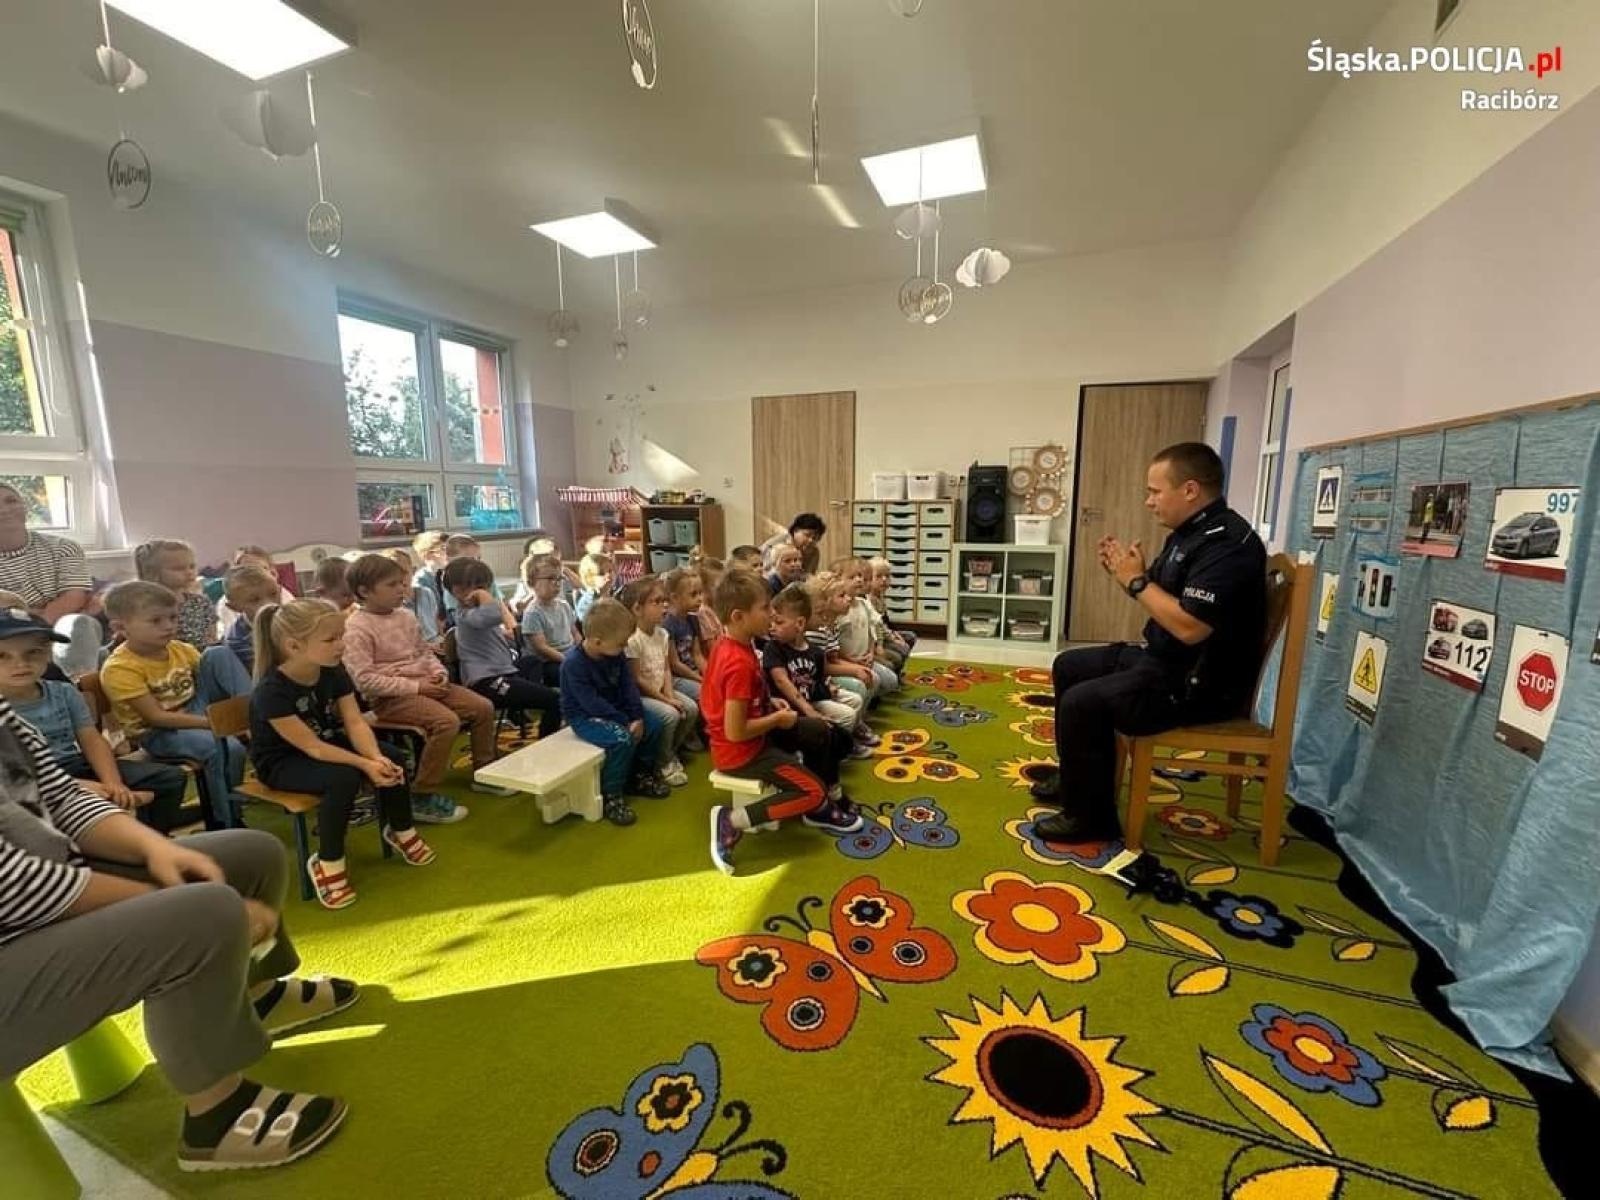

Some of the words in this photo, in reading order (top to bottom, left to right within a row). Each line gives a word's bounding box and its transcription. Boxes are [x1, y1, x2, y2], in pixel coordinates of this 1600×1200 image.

[1547, 492, 1581, 513] 997
[1183, 586, 1216, 603] POLICJA
[1455, 641, 1488, 672] 112
[1519, 669, 1555, 695] STOP
